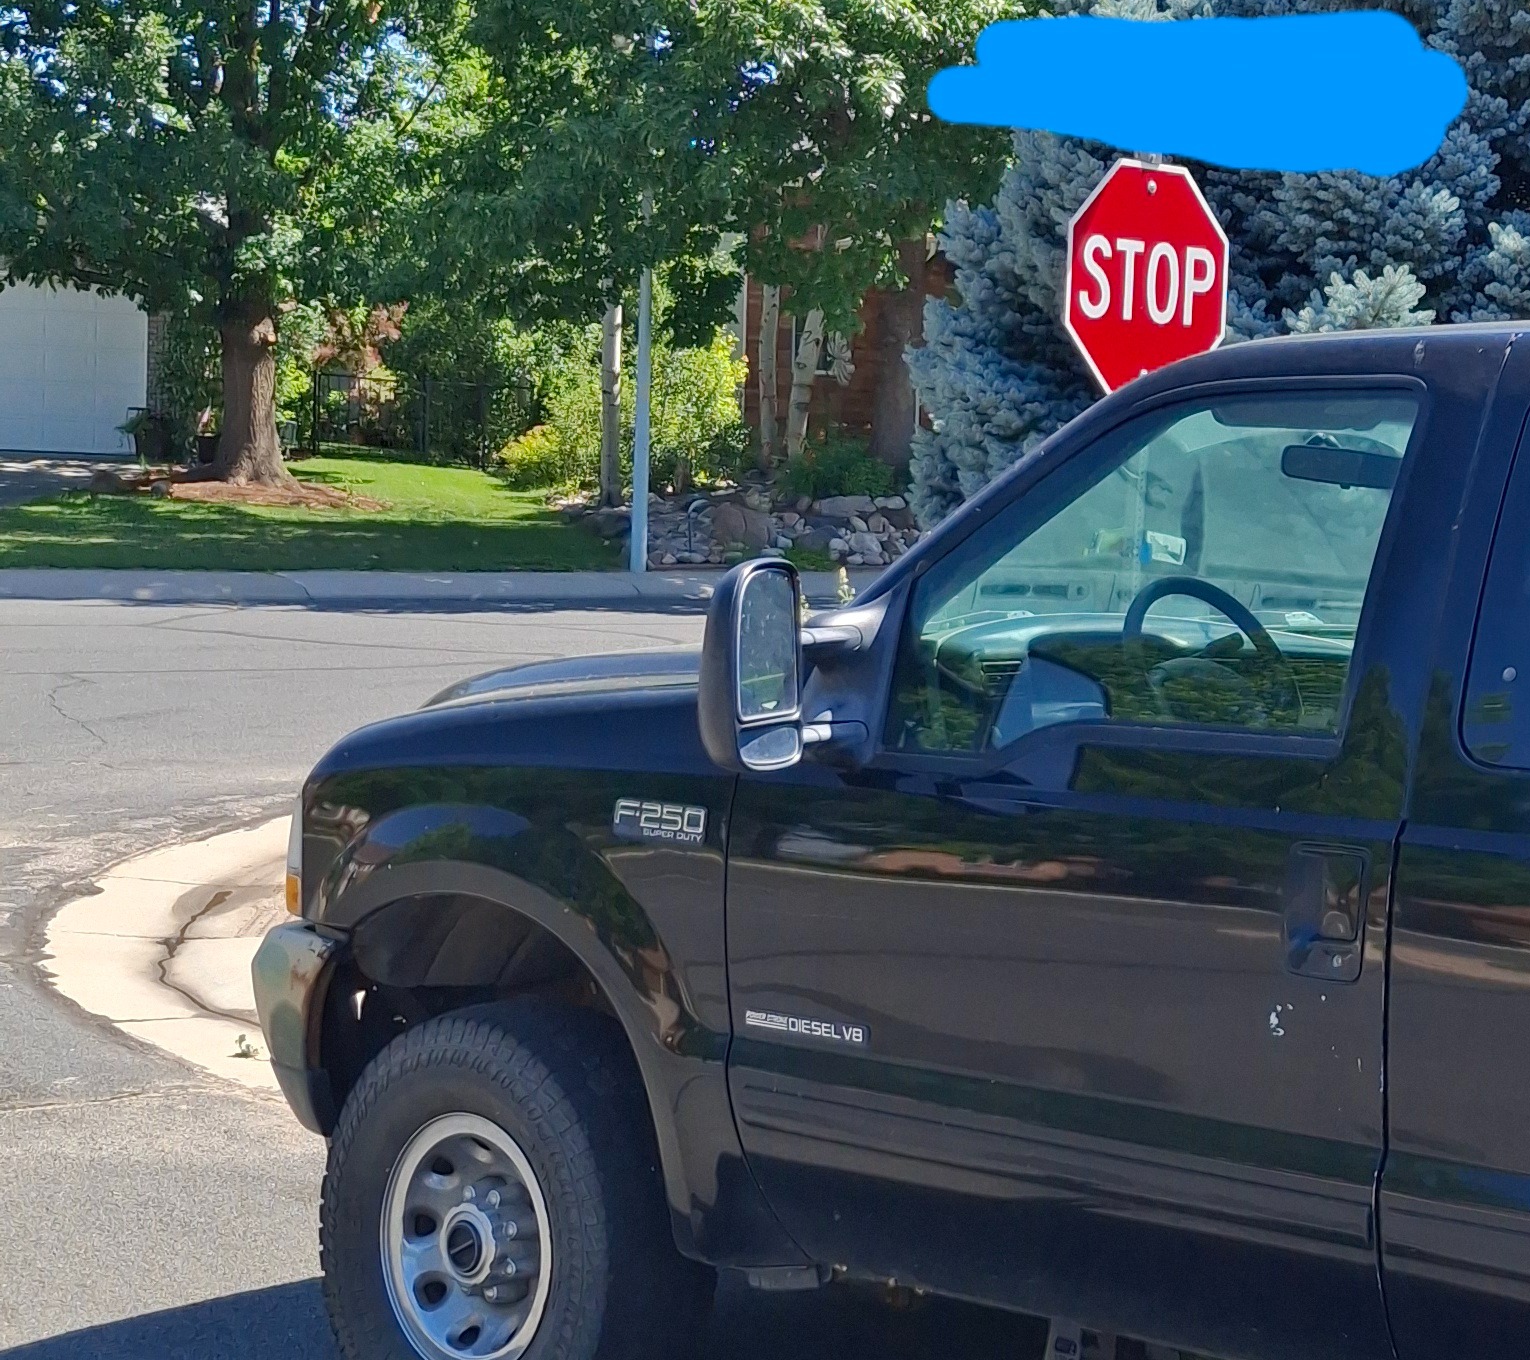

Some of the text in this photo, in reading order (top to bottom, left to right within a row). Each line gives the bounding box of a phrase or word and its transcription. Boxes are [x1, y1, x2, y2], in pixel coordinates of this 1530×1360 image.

[1078, 234, 1216, 328] STOP
[642, 827, 703, 843] SUPER DUTY
[788, 1017, 841, 1039] DIESEL
[842, 1025, 863, 1042] V8
